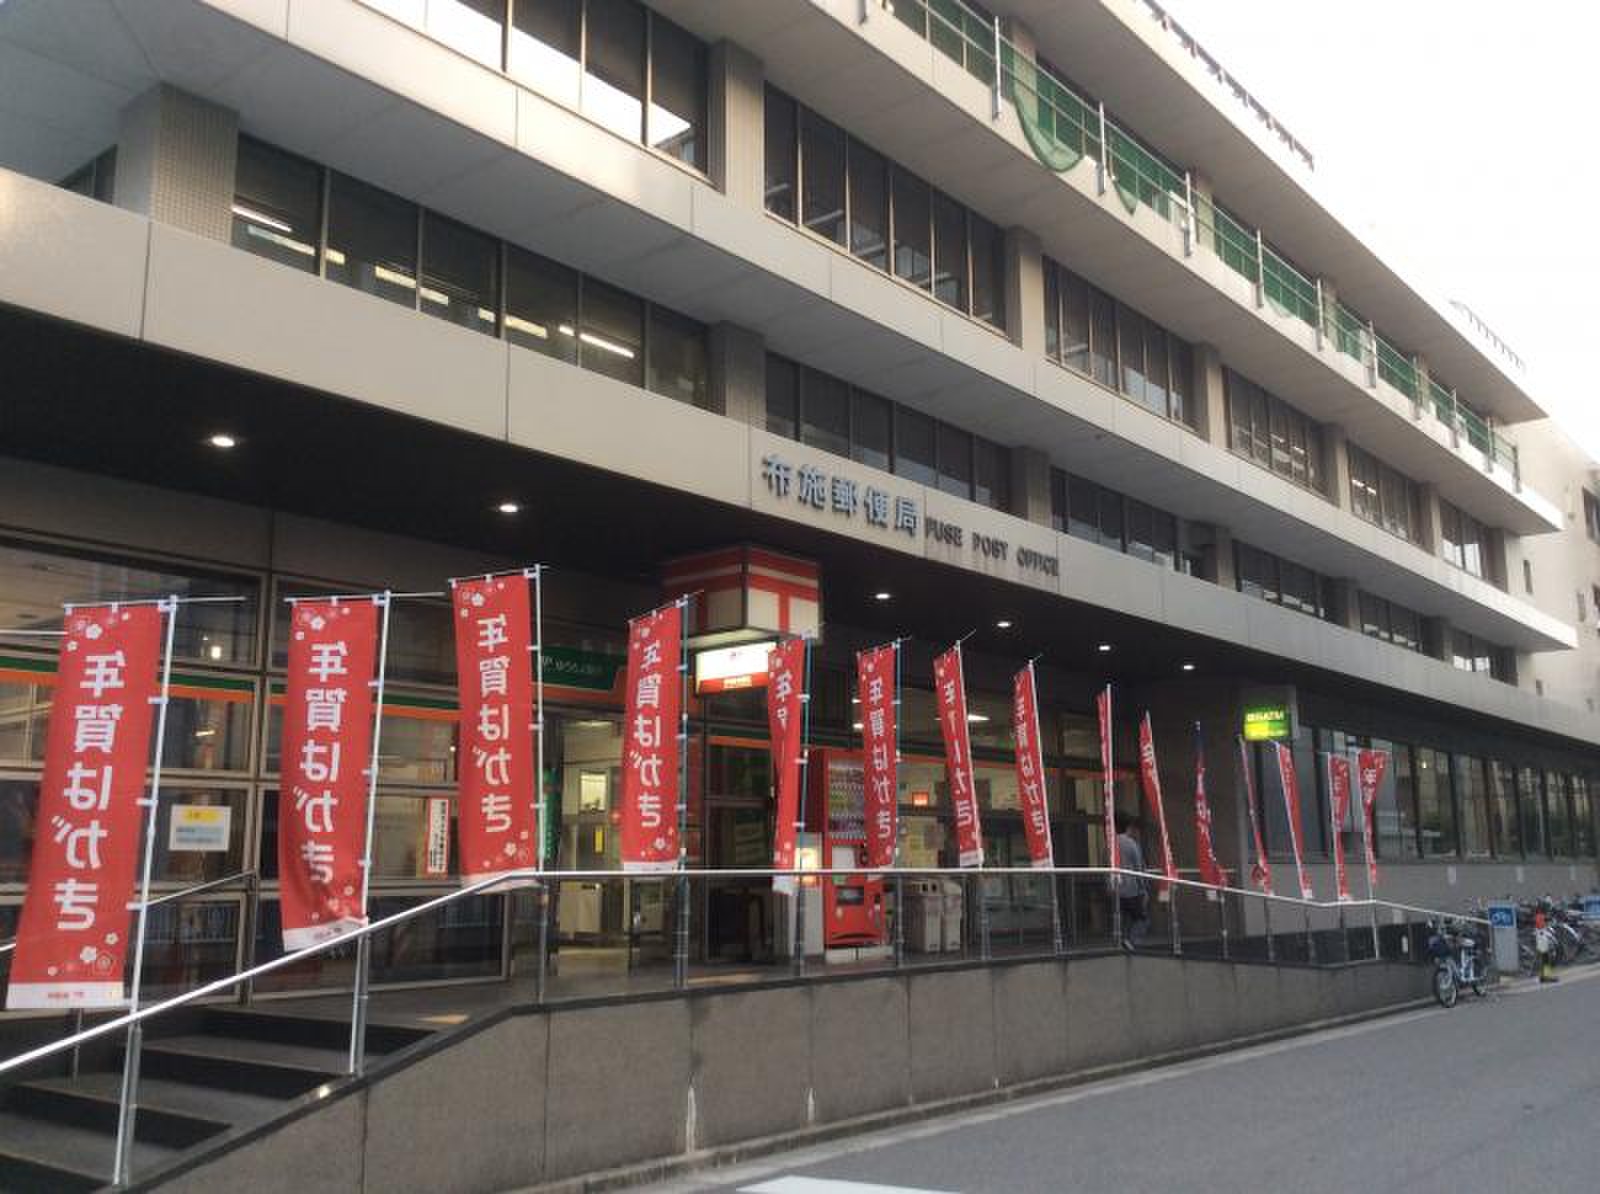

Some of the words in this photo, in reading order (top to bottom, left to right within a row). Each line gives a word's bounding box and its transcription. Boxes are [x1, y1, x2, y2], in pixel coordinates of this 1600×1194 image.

[762, 454, 918, 539] 布施郵便局
[926, 517, 963, 547] FUSE
[972, 532, 1008, 560] POST
[1016, 547, 1059, 577] OFFICE
